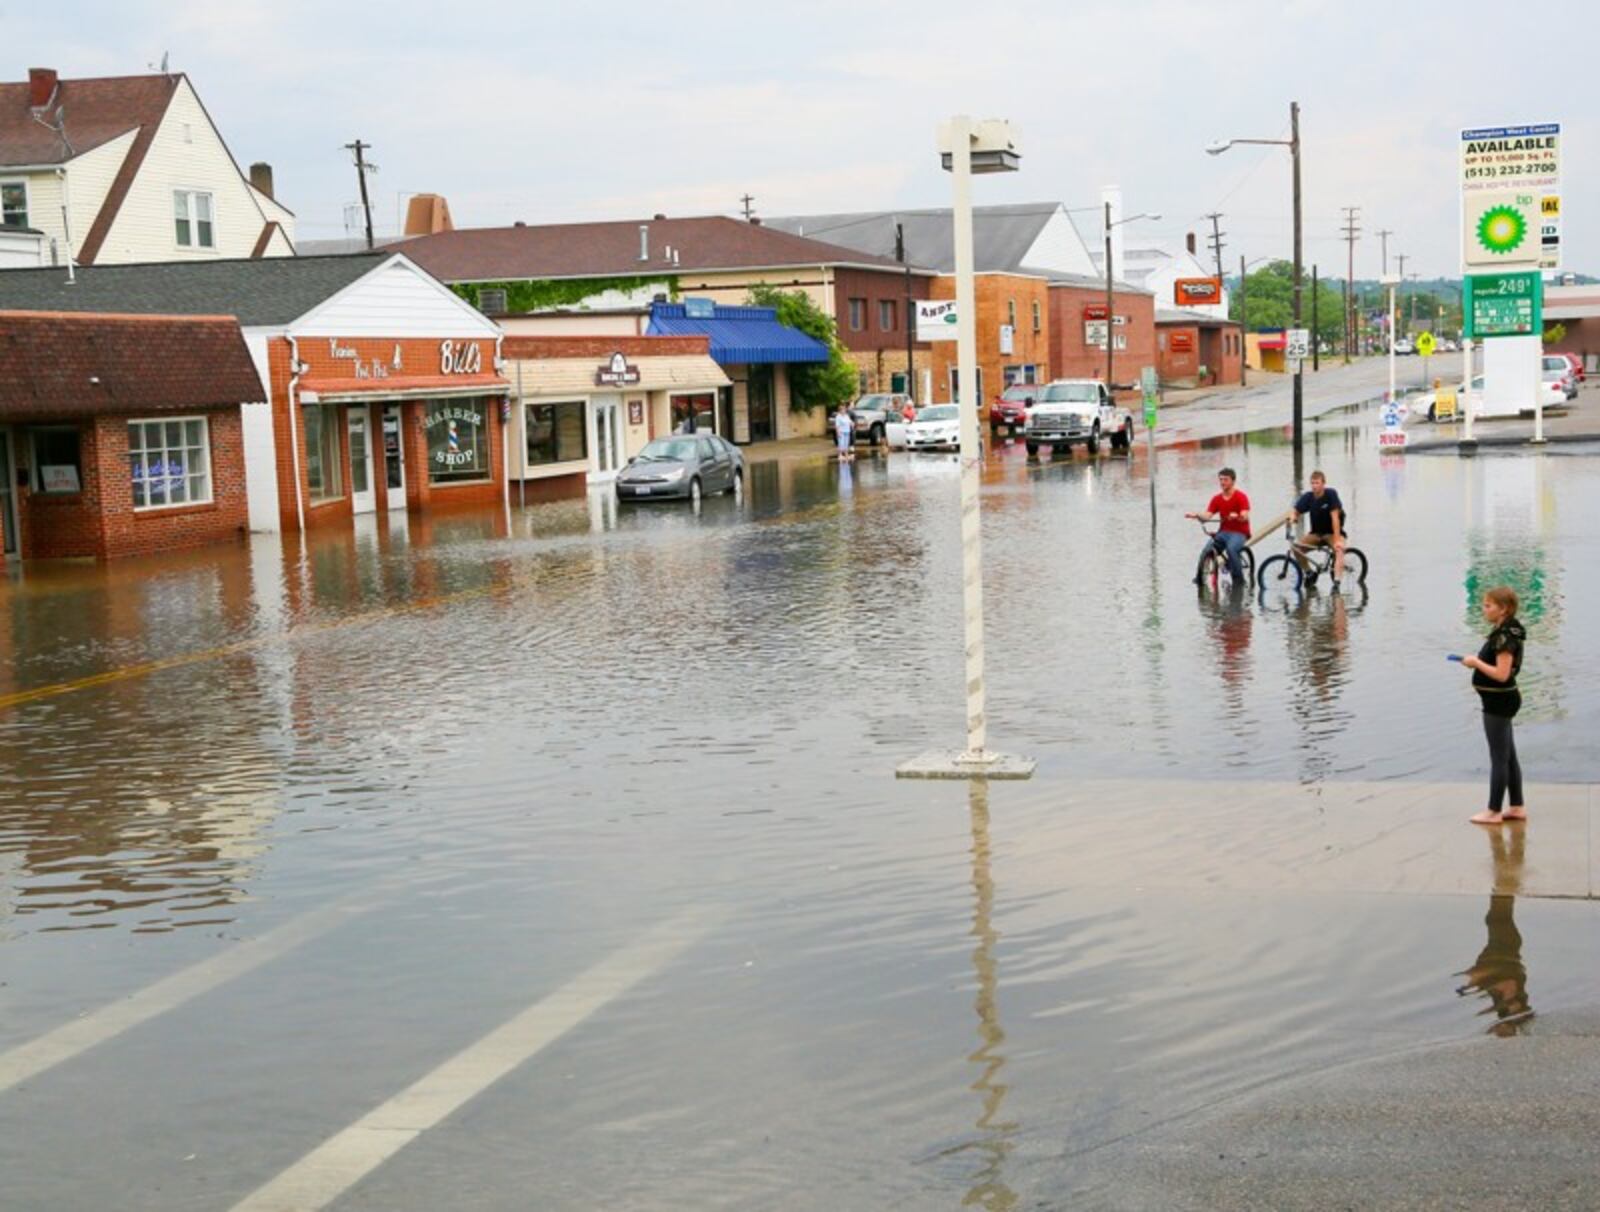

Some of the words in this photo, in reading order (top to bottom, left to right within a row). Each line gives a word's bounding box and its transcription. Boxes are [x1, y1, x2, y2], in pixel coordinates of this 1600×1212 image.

[1466, 137, 1555, 154] AVAILABLE
[1465, 167, 1496, 179] (513)
[1499, 163, 1557, 175] 232-2700
[1516, 194, 1532, 206] bp
[1288, 343, 1306, 356] 25
[425, 407, 481, 429] BARBER
[435, 449, 473, 465] SHOP
